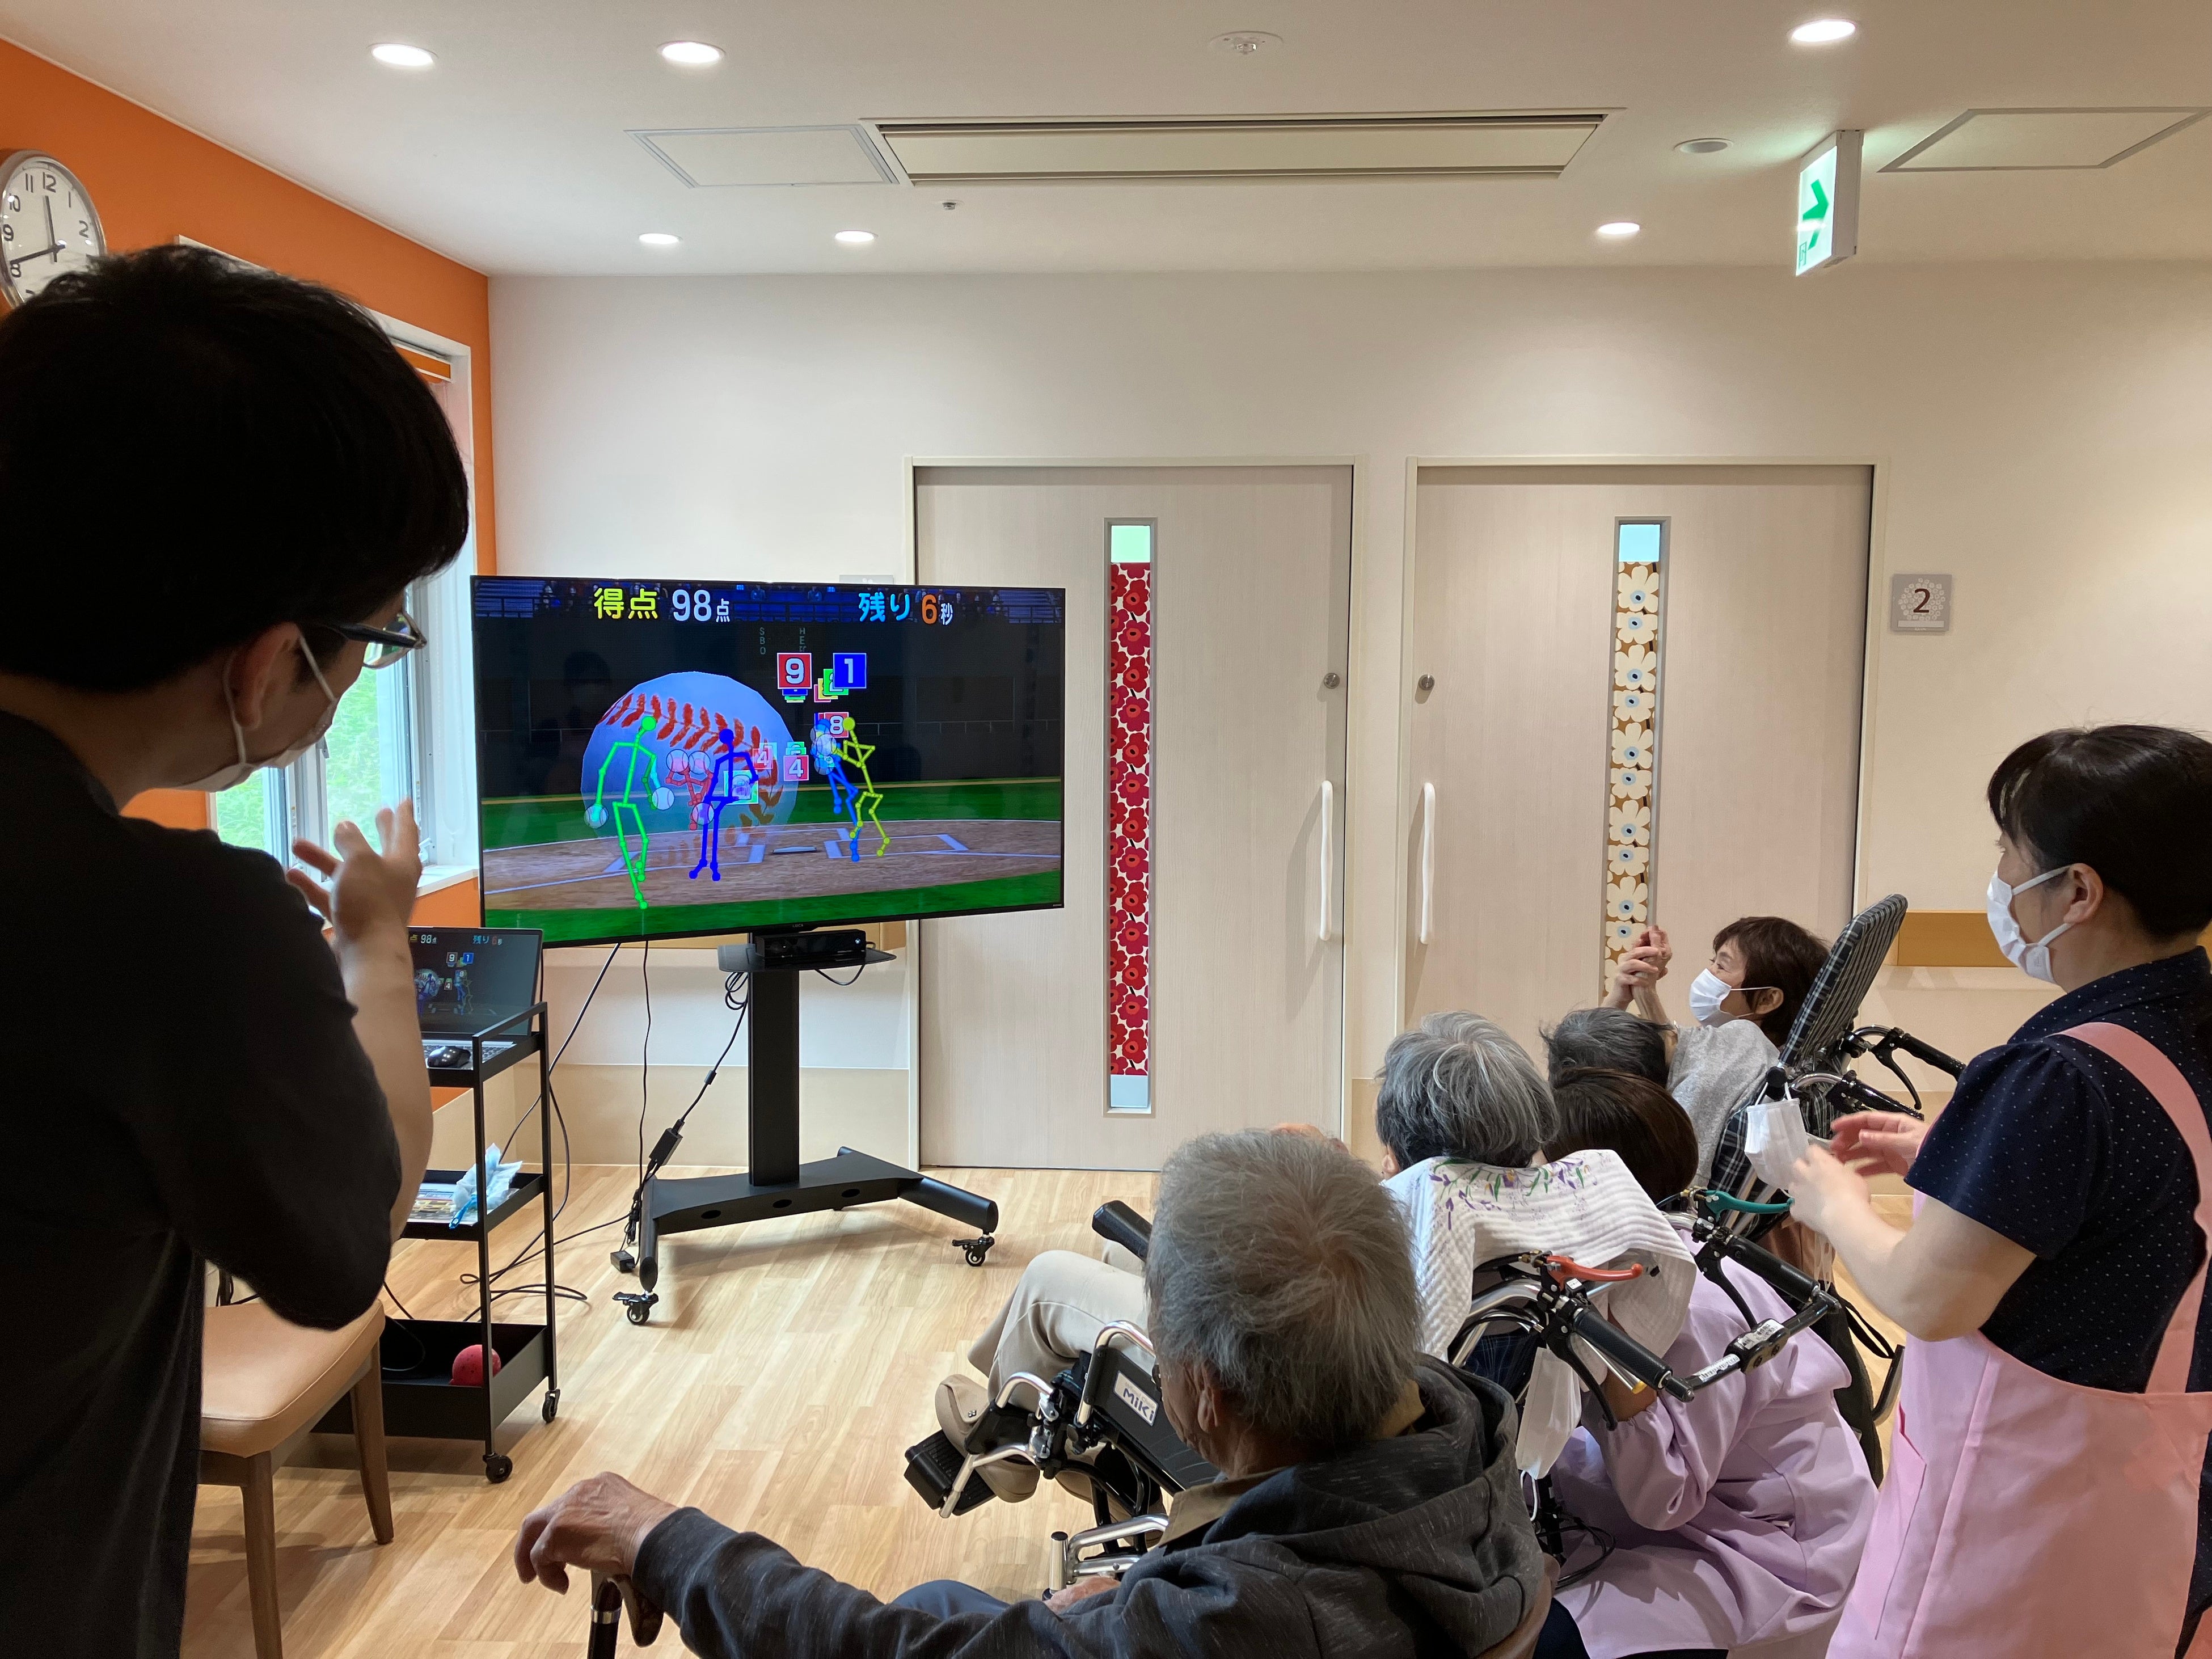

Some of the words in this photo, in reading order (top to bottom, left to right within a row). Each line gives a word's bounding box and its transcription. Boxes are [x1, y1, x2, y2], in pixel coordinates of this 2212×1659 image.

[25, 173, 33, 193] 11
[43, 172, 56, 193] 12
[9, 193, 21, 212] 10
[68, 191, 71, 208] 1
[3, 224, 14, 241] 9
[79, 220, 89, 238] 2
[10, 261, 22, 278] 8
[594, 588, 658, 619] 得点
[858, 592, 910, 622] 残り
[1913, 588, 1930, 613] 2
[786, 658, 804, 684] 9
[844, 658, 854, 683] 1
[830, 715, 844, 734] 8
[757, 751, 769, 766] 4
[789, 759, 804, 778] 4
